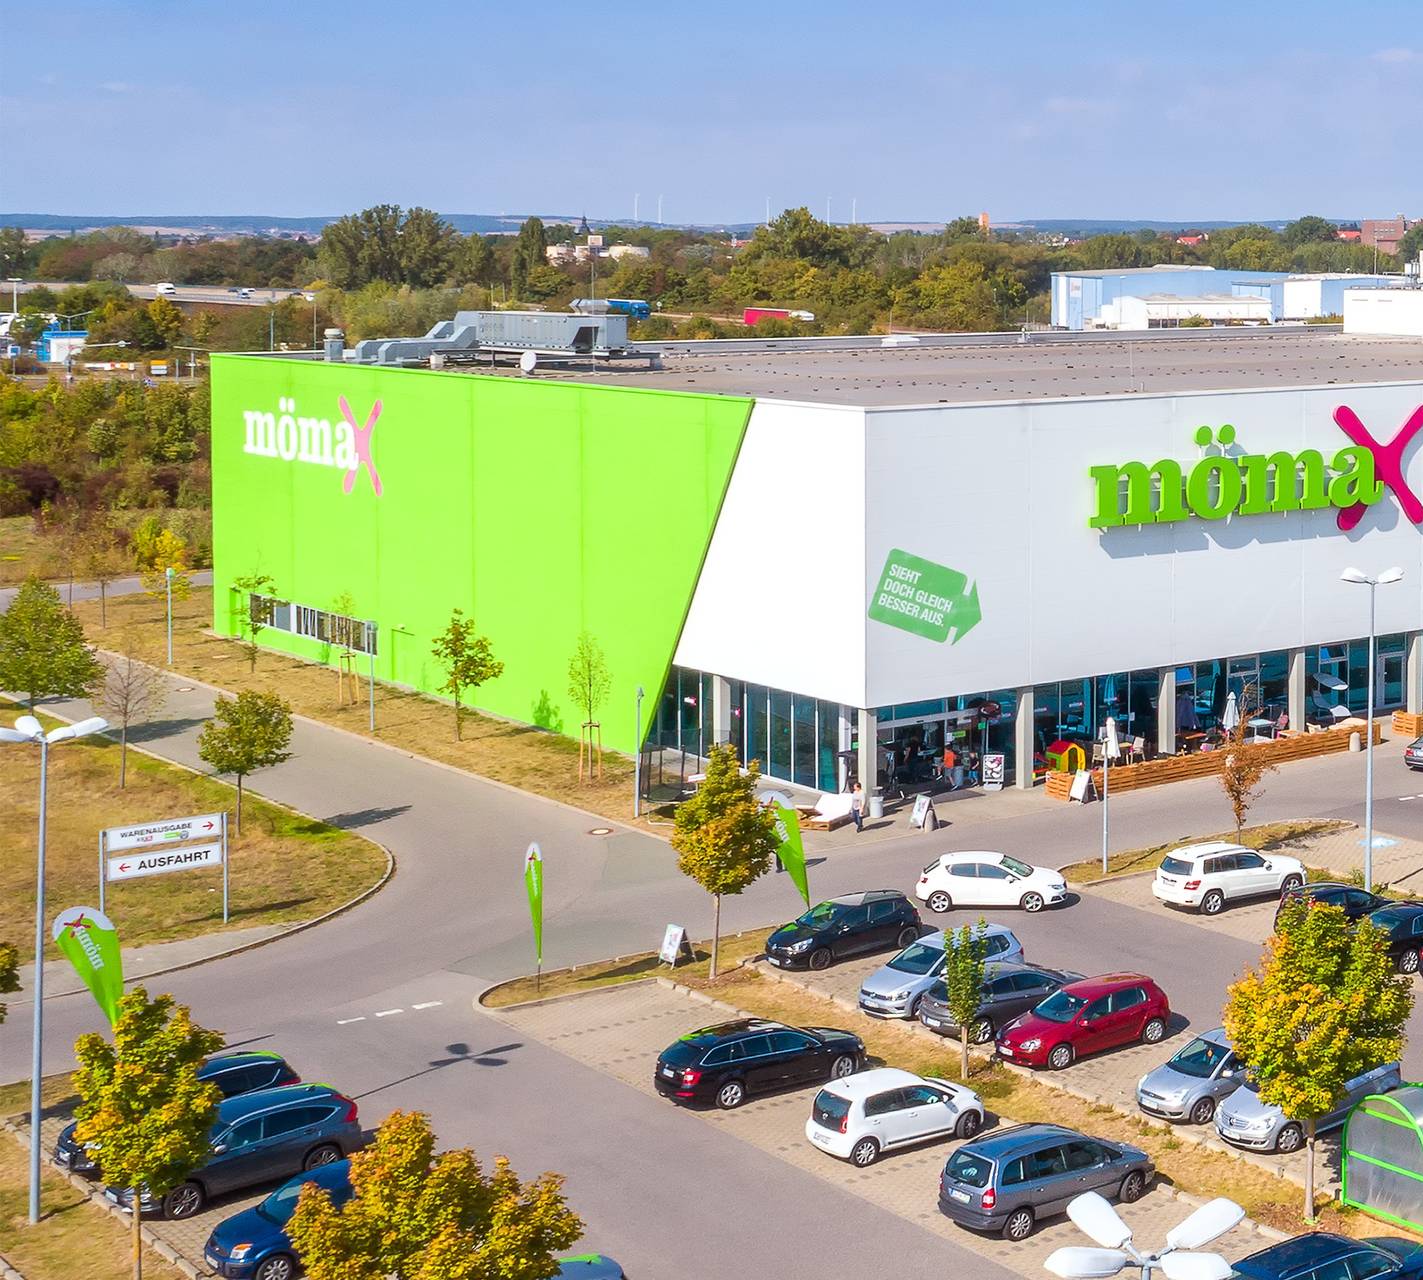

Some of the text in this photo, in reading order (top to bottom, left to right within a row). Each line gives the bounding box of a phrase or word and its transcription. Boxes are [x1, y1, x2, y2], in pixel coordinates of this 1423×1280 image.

[889, 564, 922, 584] SIEHT
[884, 578, 953, 612] DOCH GLEICH
[879, 593, 944, 627] BESSER AUS.
[120, 822, 192, 838] WARENAUSGABE
[138, 850, 211, 870] AUSFAHRT
